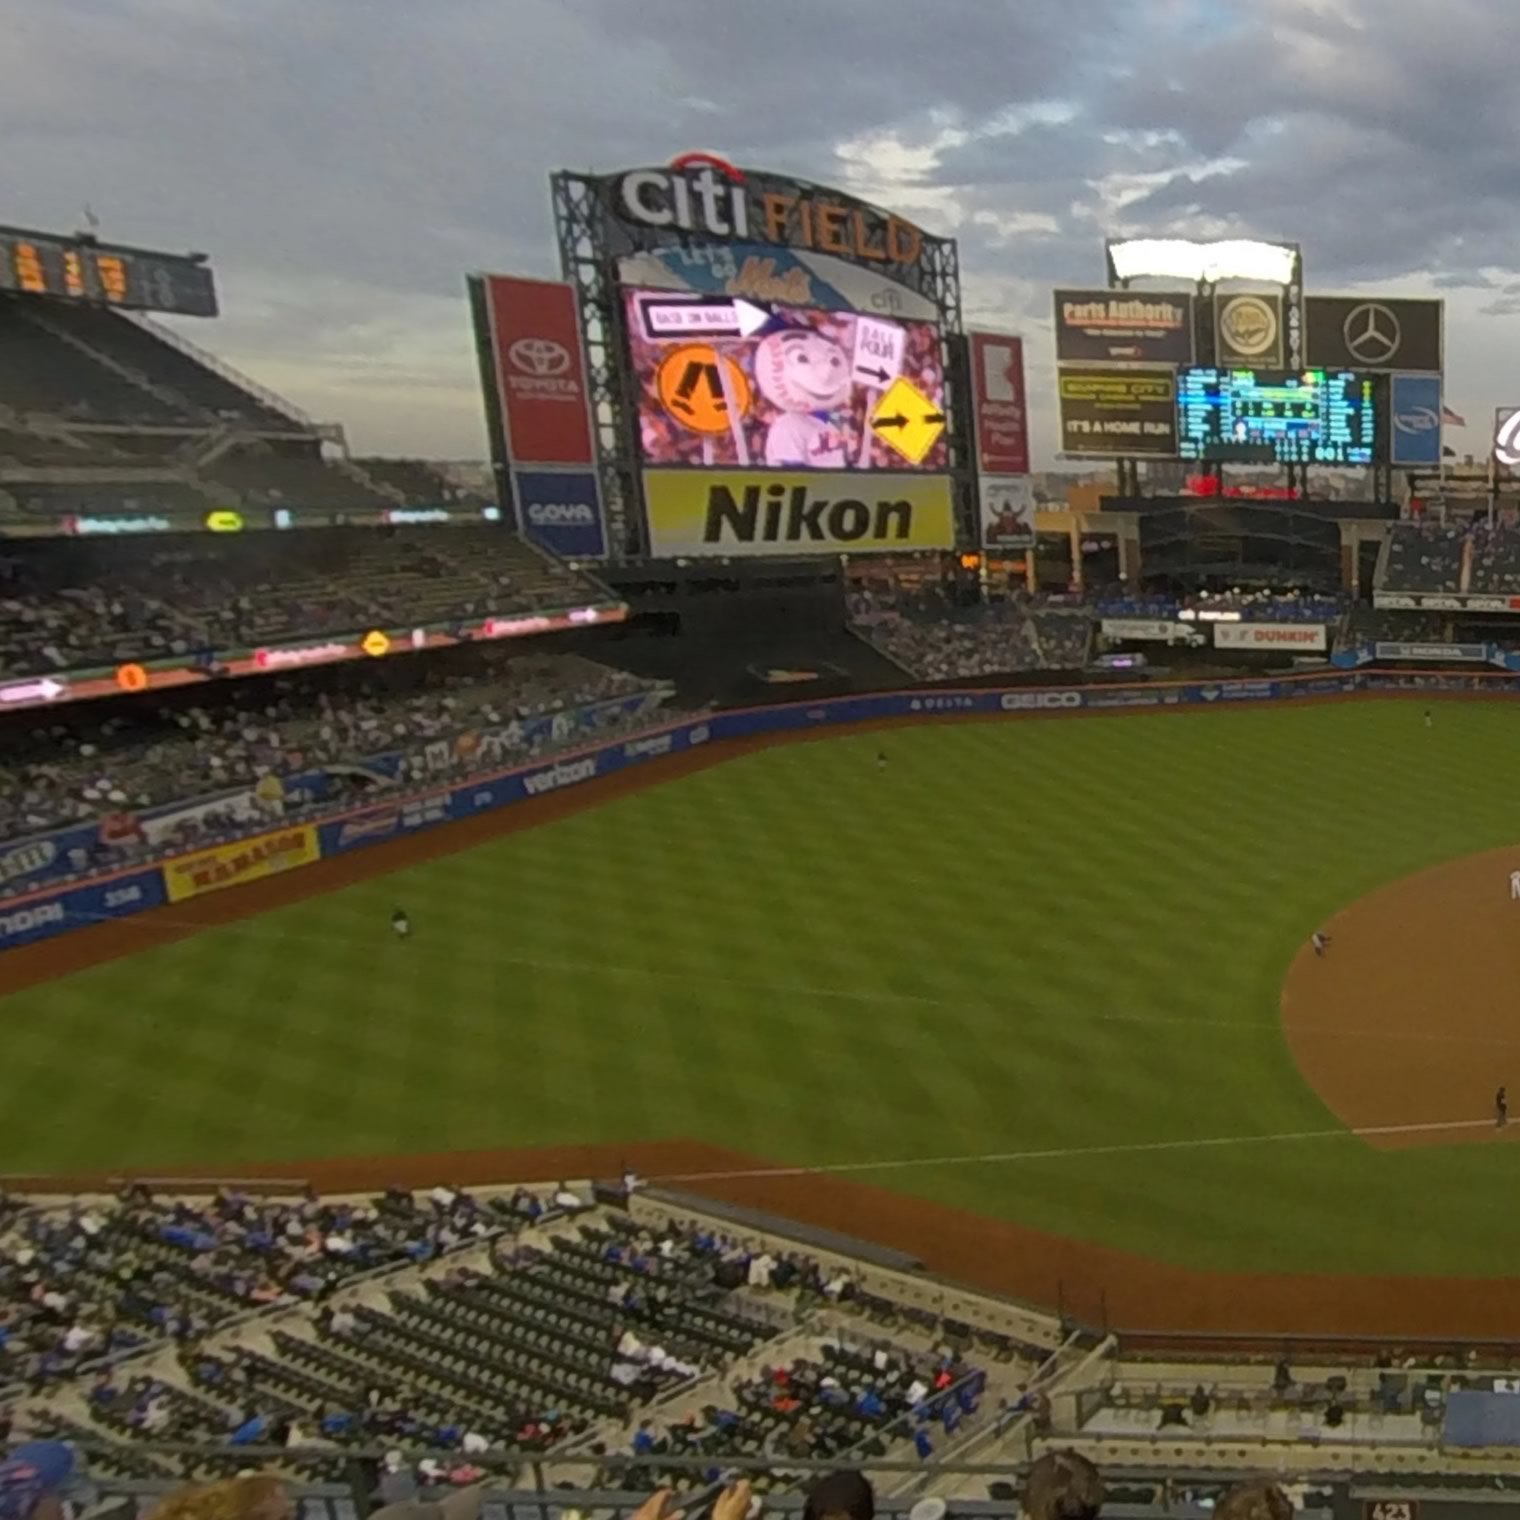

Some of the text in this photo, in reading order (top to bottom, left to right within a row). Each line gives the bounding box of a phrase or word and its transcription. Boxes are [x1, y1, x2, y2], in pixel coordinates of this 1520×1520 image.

[762, 191, 922, 264] FIELD
[1062, 299, 1184, 322] Parts Authority
[861, 325, 894, 341] BALL
[508, 375, 579, 393] TOYOTA
[1066, 420, 1170, 435] IT'S A HOME RUN
[528, 503, 593, 521] GOYA
[703, 483, 913, 543] Nikon
[1412, 647, 1463, 657] HONDA
[1000, 691, 1082, 710] GEICO
[522, 758, 597, 795] verizon
